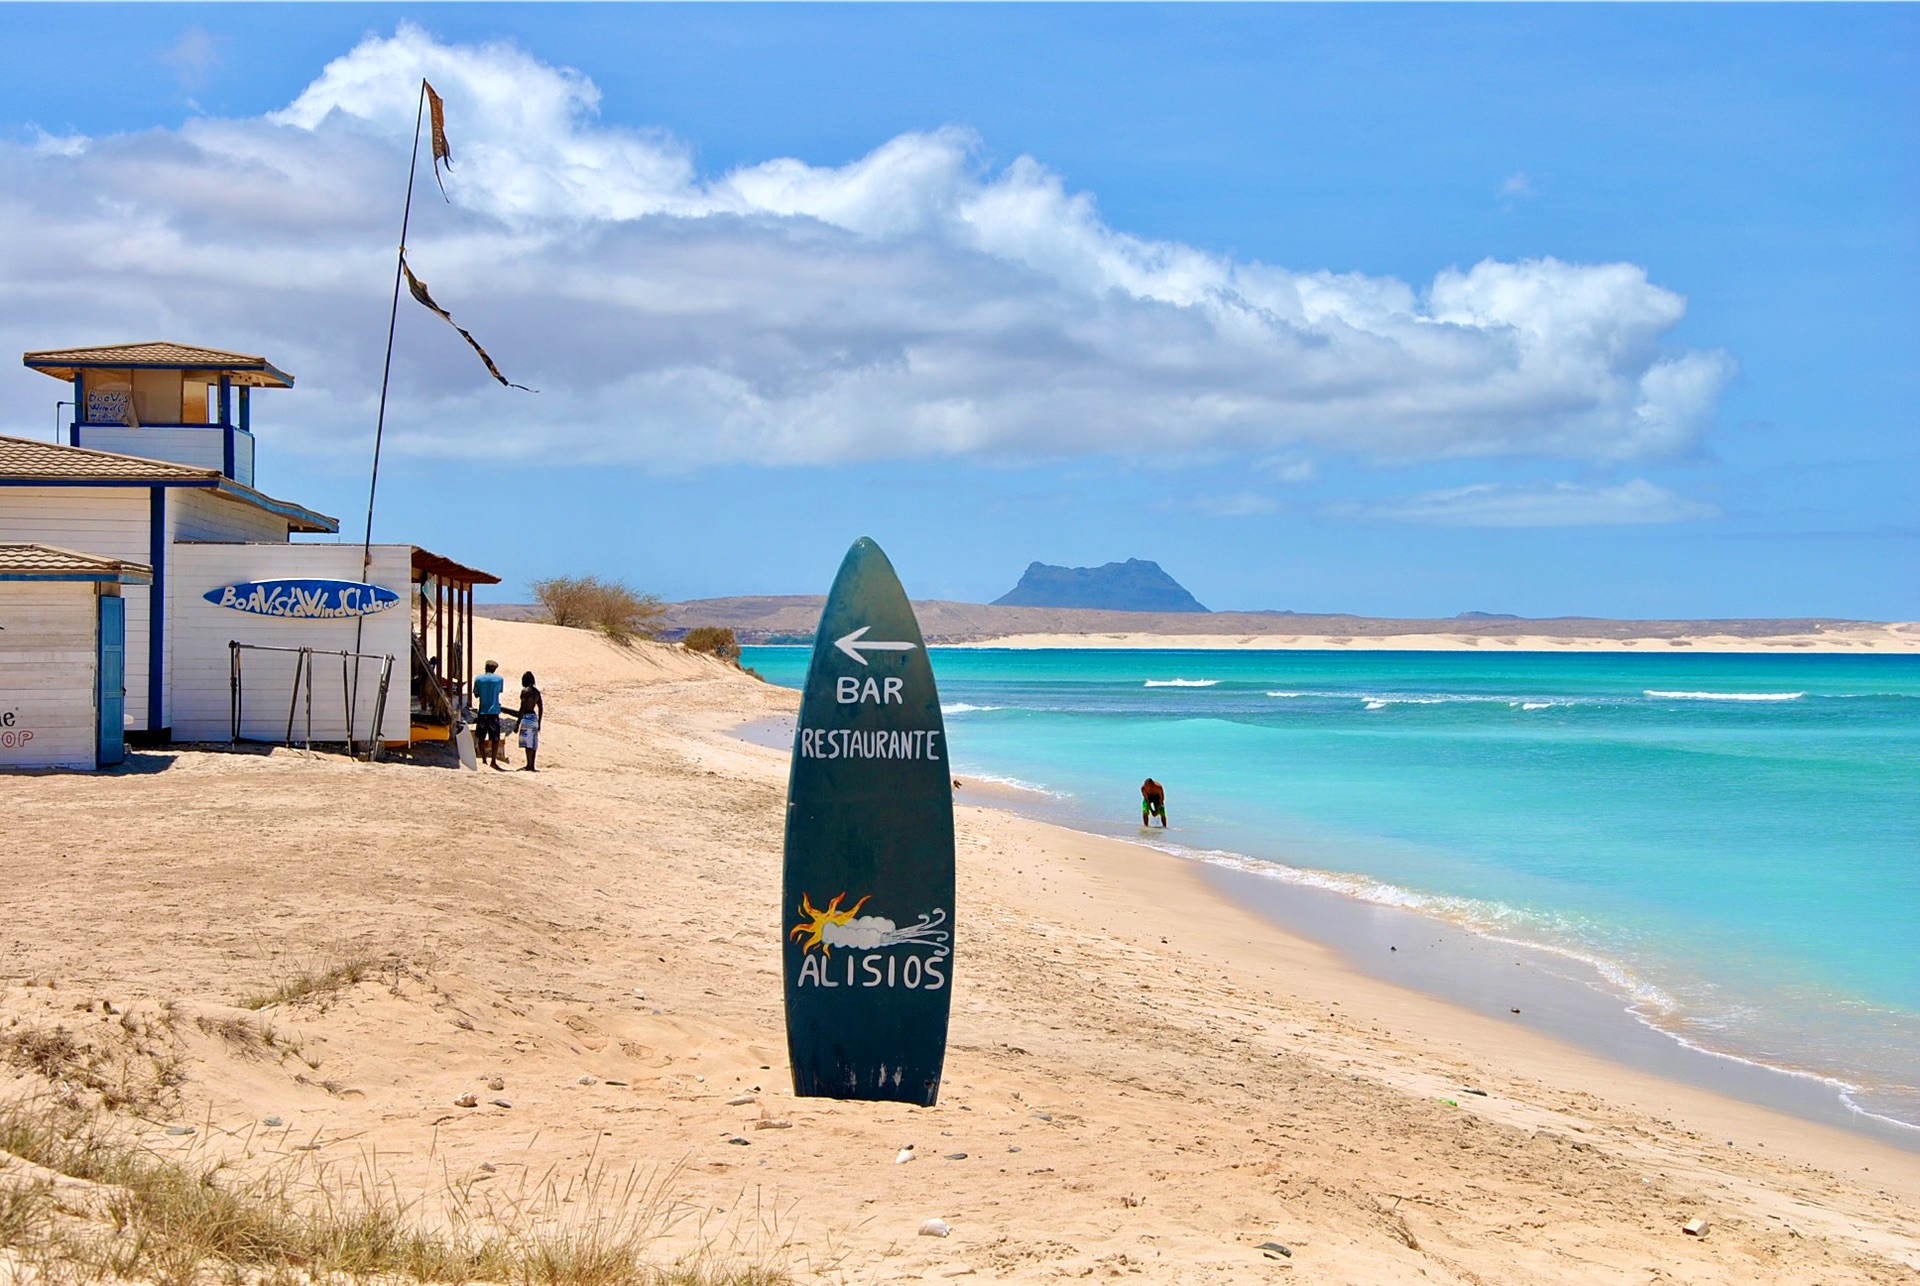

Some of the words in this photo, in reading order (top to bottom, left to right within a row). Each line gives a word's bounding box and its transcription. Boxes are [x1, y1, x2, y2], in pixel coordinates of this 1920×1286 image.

[836, 676, 904, 705] BAR
[801, 728, 940, 760] RESTAURANTE
[797, 954, 945, 990] ALISIOS
